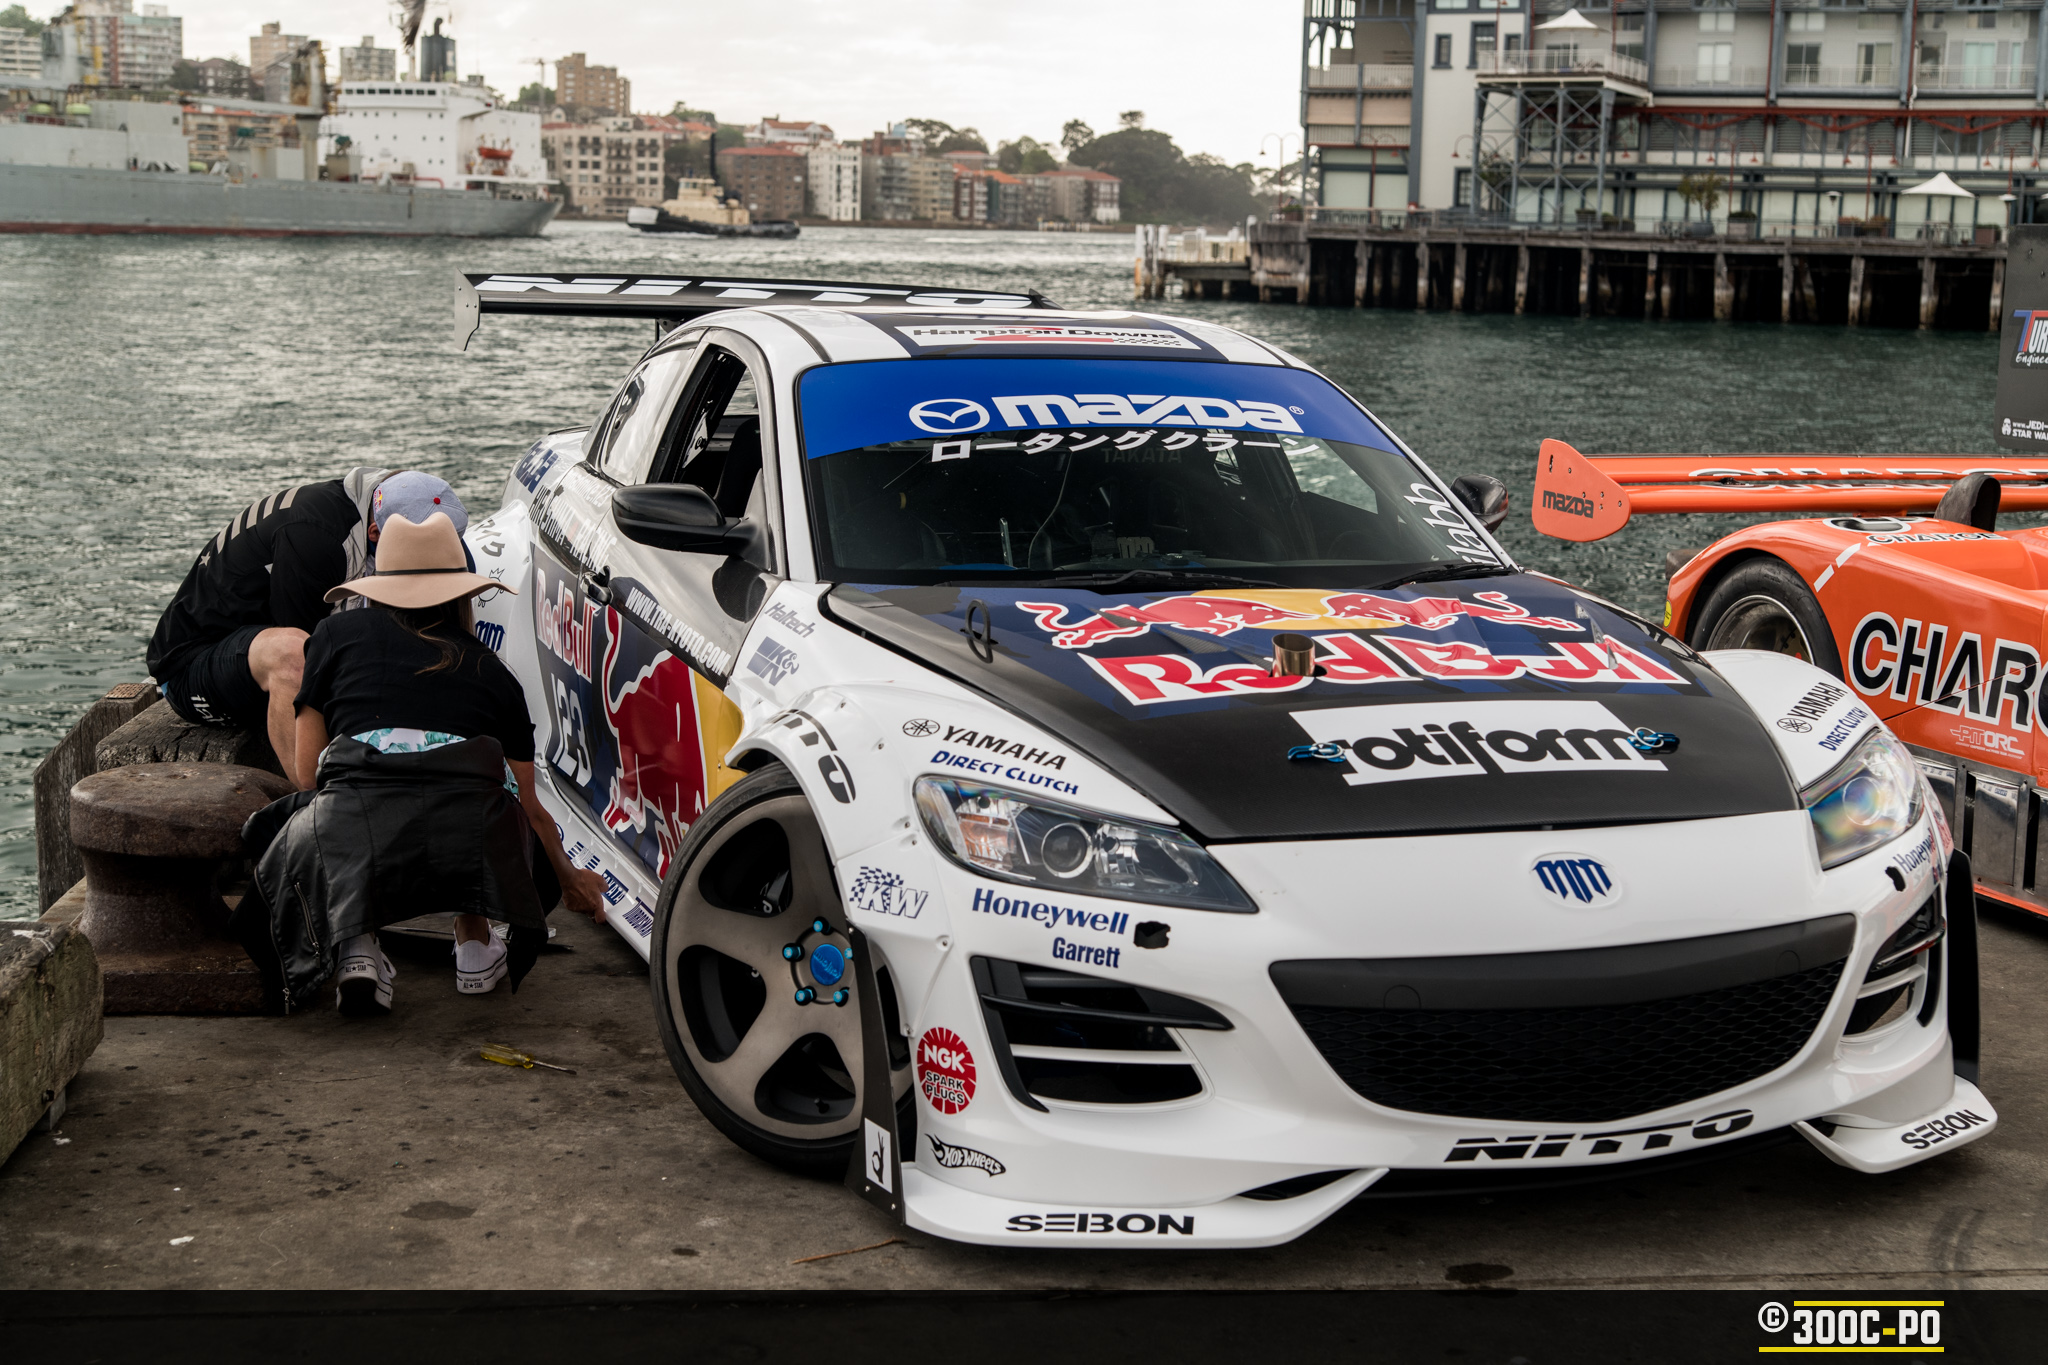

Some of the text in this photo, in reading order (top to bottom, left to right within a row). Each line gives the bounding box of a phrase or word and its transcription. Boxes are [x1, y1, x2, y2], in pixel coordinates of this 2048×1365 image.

[475, 275, 1031, 309] NITTO
[913, 328, 1177, 339] Hampton Downs
[2012, 428, 2032, 439] STAR
[1403, 483, 1505, 569] ilabb
[625, 587, 731, 675] WWW.TRA-KYOTO.COM
[764, 602, 815, 638] Haltech
[1787, 682, 1848, 720] YAMAHA
[551, 672, 593, 787] 123
[942, 725, 1067, 771] YAMAHA
[1332, 721, 1648, 774] rotiform
[1818, 707, 1868, 751] DIRECT CLUTCH
[930, 750, 1079, 795] DIRECT CLUTCH
[858, 882, 929, 919] KW
[972, 887, 1130, 934] Honeywell
[1052, 937, 1121, 968] Garrett
[924, 1043, 966, 1073] NGK
[926, 1071, 964, 1091] SPARK
[926, 1084, 965, 1105] PLUGS
[1443, 1108, 1755, 1162] NITTO
[1900, 1108, 1989, 1150] SEBON
[1005, 1213, 1195, 1236] SEBON
